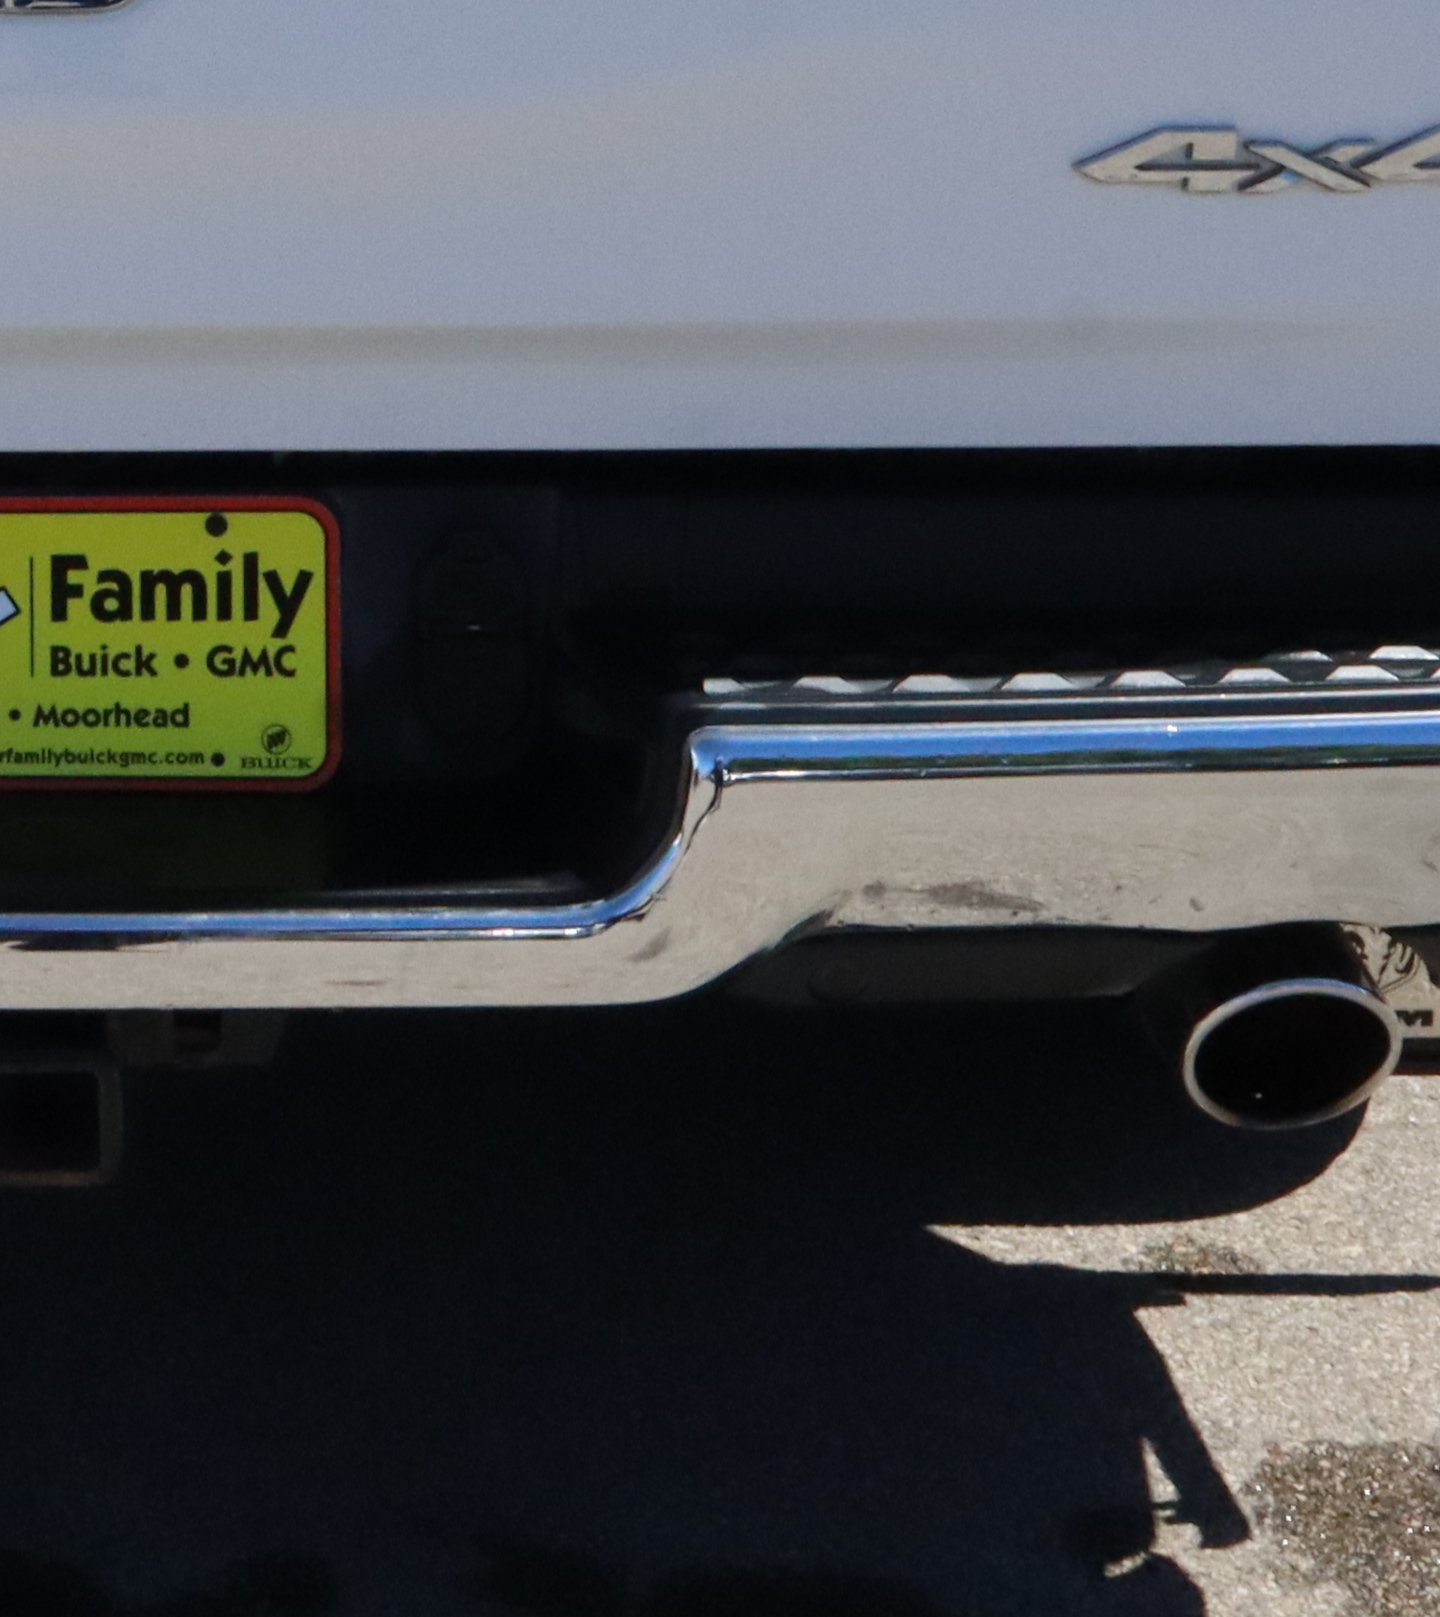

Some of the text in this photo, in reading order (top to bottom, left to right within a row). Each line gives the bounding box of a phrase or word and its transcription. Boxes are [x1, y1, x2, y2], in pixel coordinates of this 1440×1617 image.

[49, 549, 315, 639] Family
[49, 645, 297, 678] Buick GMC
[33, 702, 191, 729] Moorhead
[240, 756, 314, 770] BUICK
